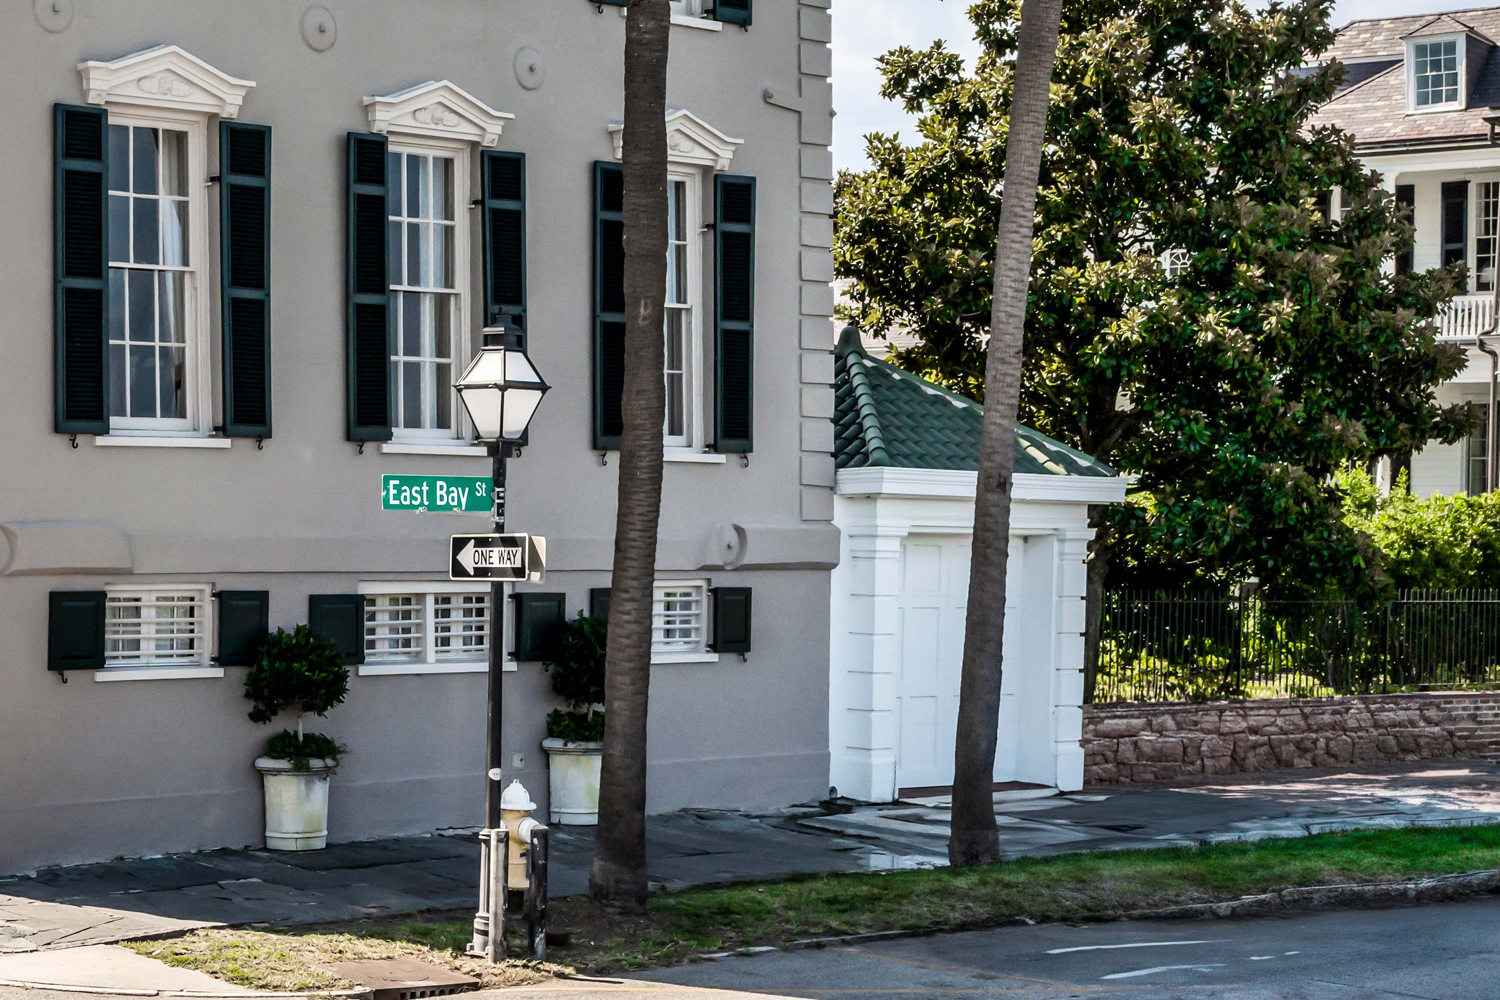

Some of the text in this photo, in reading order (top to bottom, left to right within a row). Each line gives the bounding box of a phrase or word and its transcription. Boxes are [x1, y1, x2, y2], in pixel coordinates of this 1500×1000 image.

[389, 480, 486, 510] East Bay St
[473, 549, 518, 565] ONE WAY
